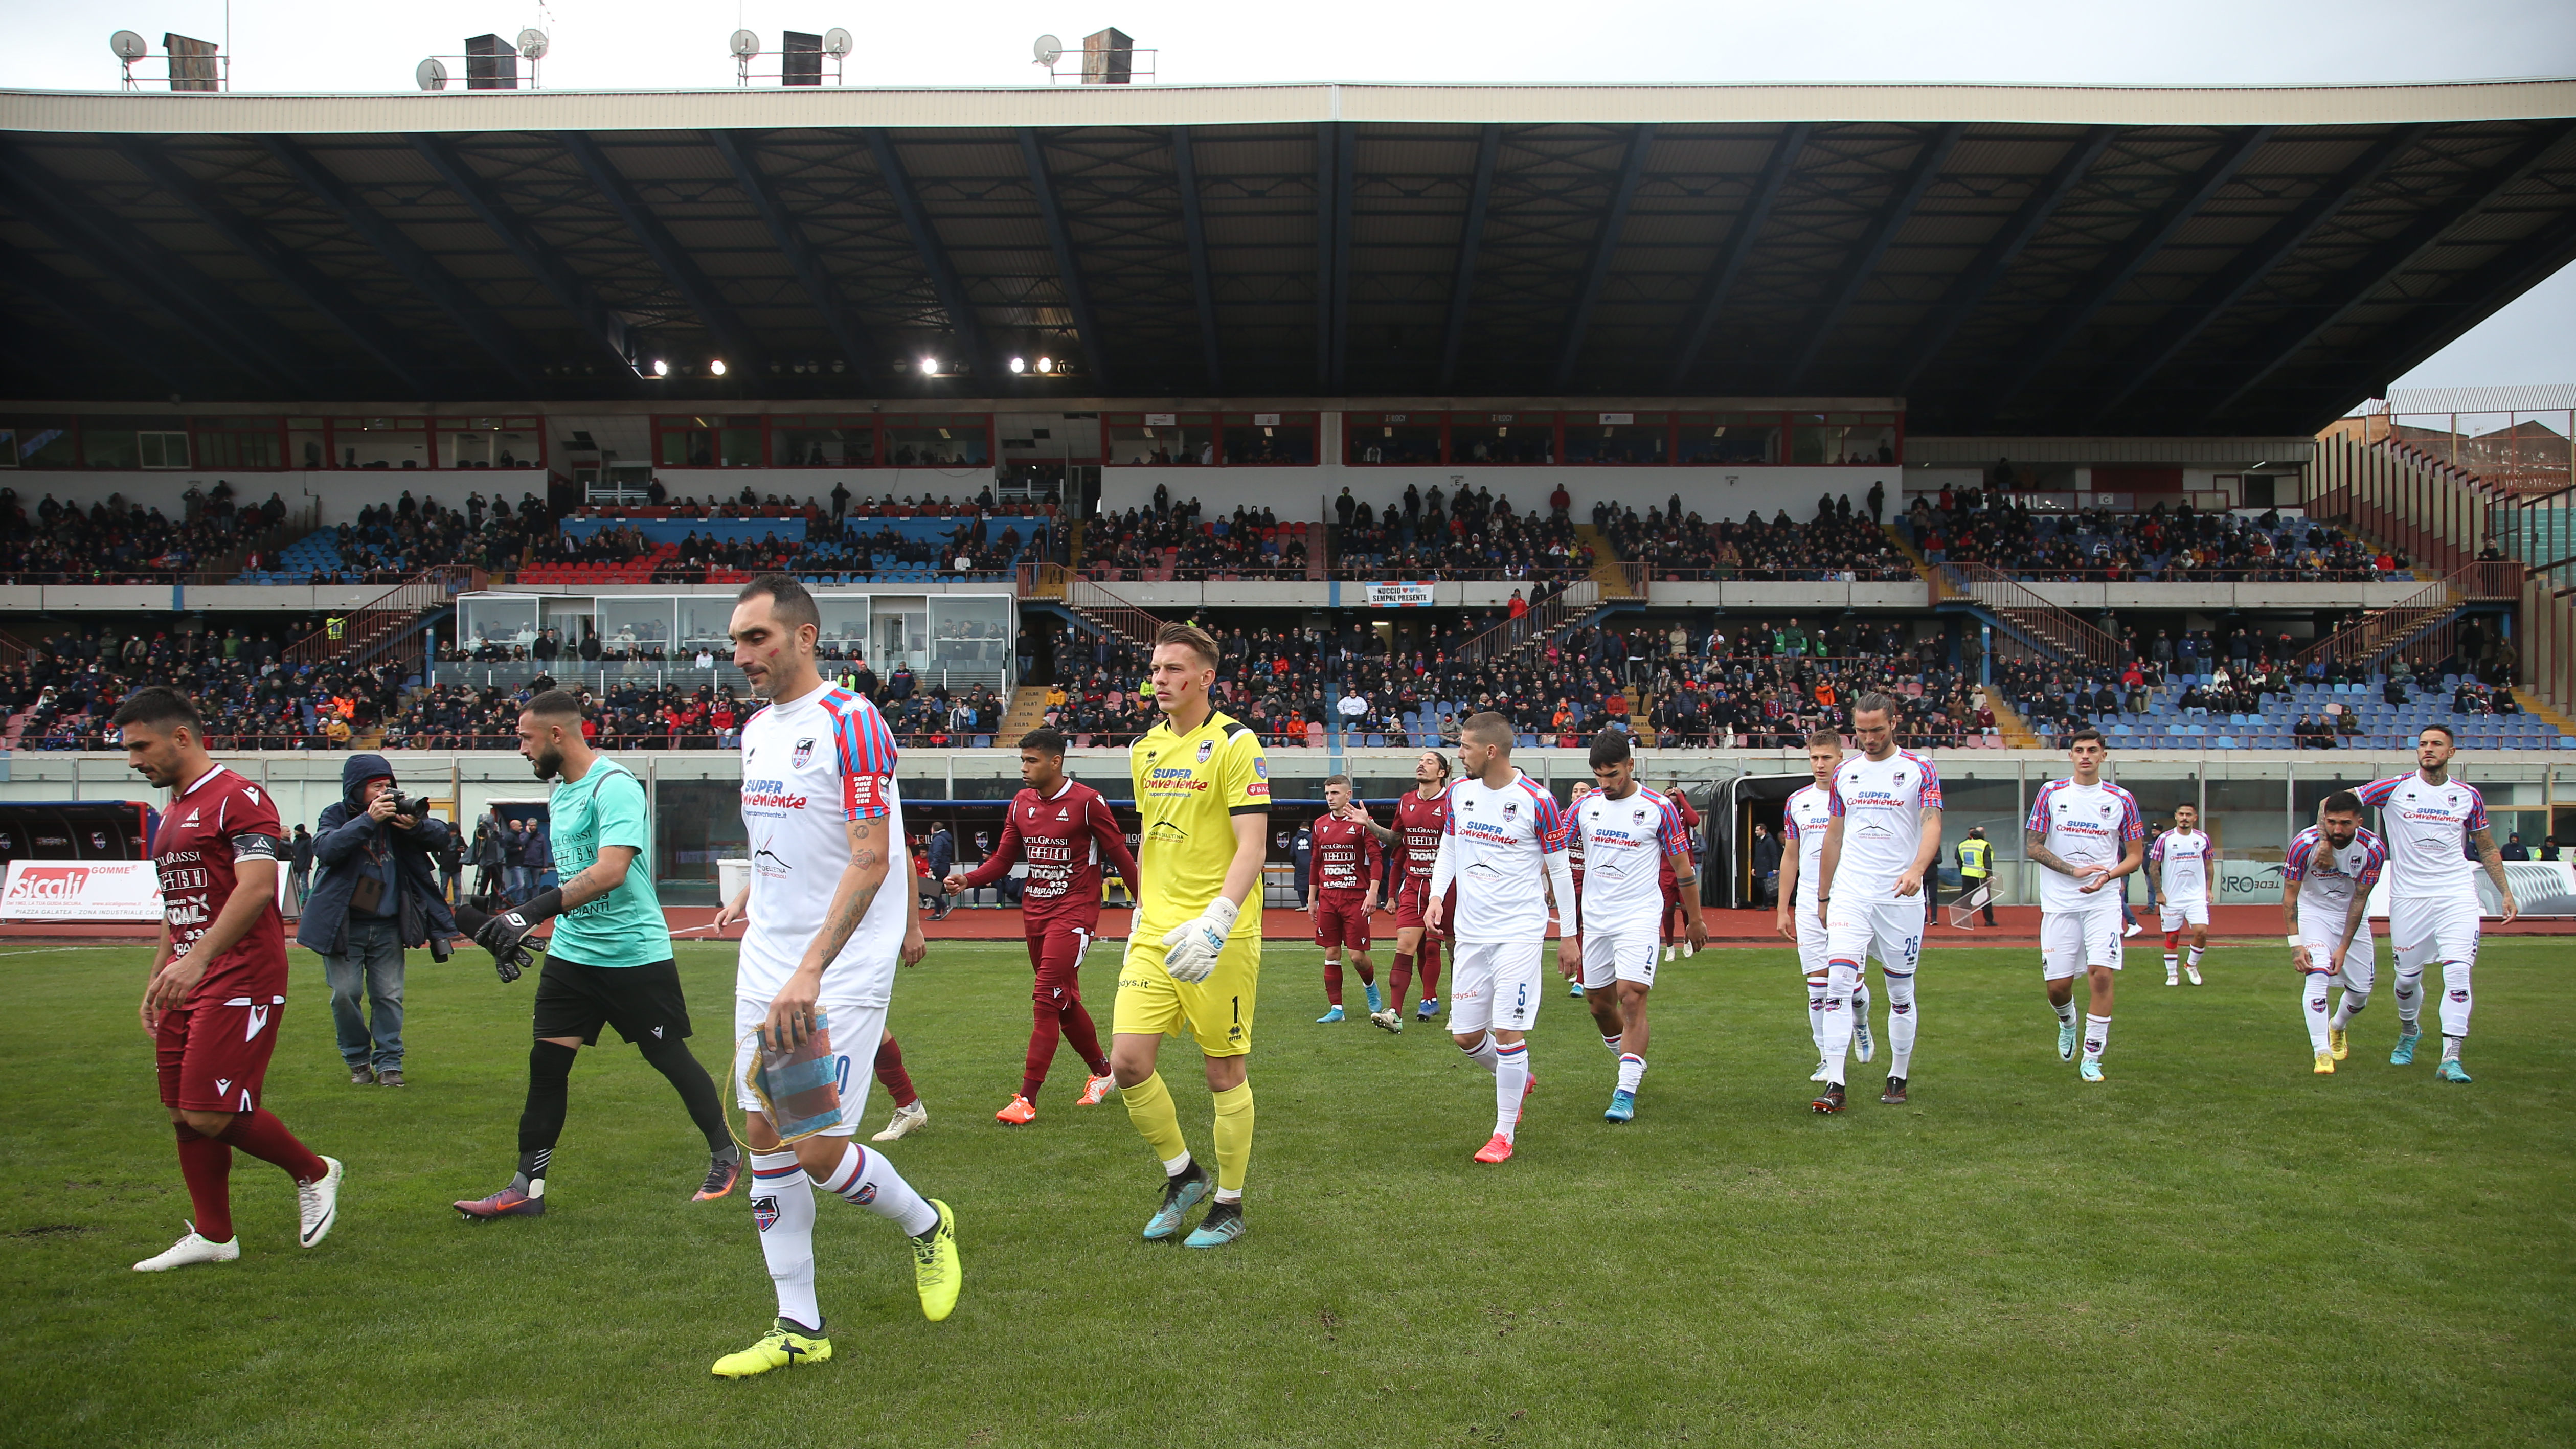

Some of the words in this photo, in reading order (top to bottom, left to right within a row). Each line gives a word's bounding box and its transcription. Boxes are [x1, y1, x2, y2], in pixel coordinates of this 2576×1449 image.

[1153, 768, 1192, 779] SUPER
[745, 779, 783, 794] SUPER
[1143, 778, 1208, 791] Conveniente
[1847, 797, 1905, 806] Conveniente
[2403, 811, 2460, 823] Conveniente
[2416, 807, 2450, 816] SUPER
[1466, 821, 1503, 835] SUPER
[2056, 824, 2109, 836] Conveniente
[2067, 821, 2099, 829] SUPER
[915, 834, 933, 844] TRIL
[1458, 826, 1518, 846] Conveniente
[1596, 828, 1630, 839] SUPER
[1589, 834, 1642, 848] Conveniente
[11, 871, 84, 898] sicali
[1904, 935, 1918, 956] 26
[1646, 945, 1653, 965] 2
[1518, 983, 1526, 1006] 5
[1232, 995, 1238, 1024] 1
[833, 1054, 851, 1095] 0
